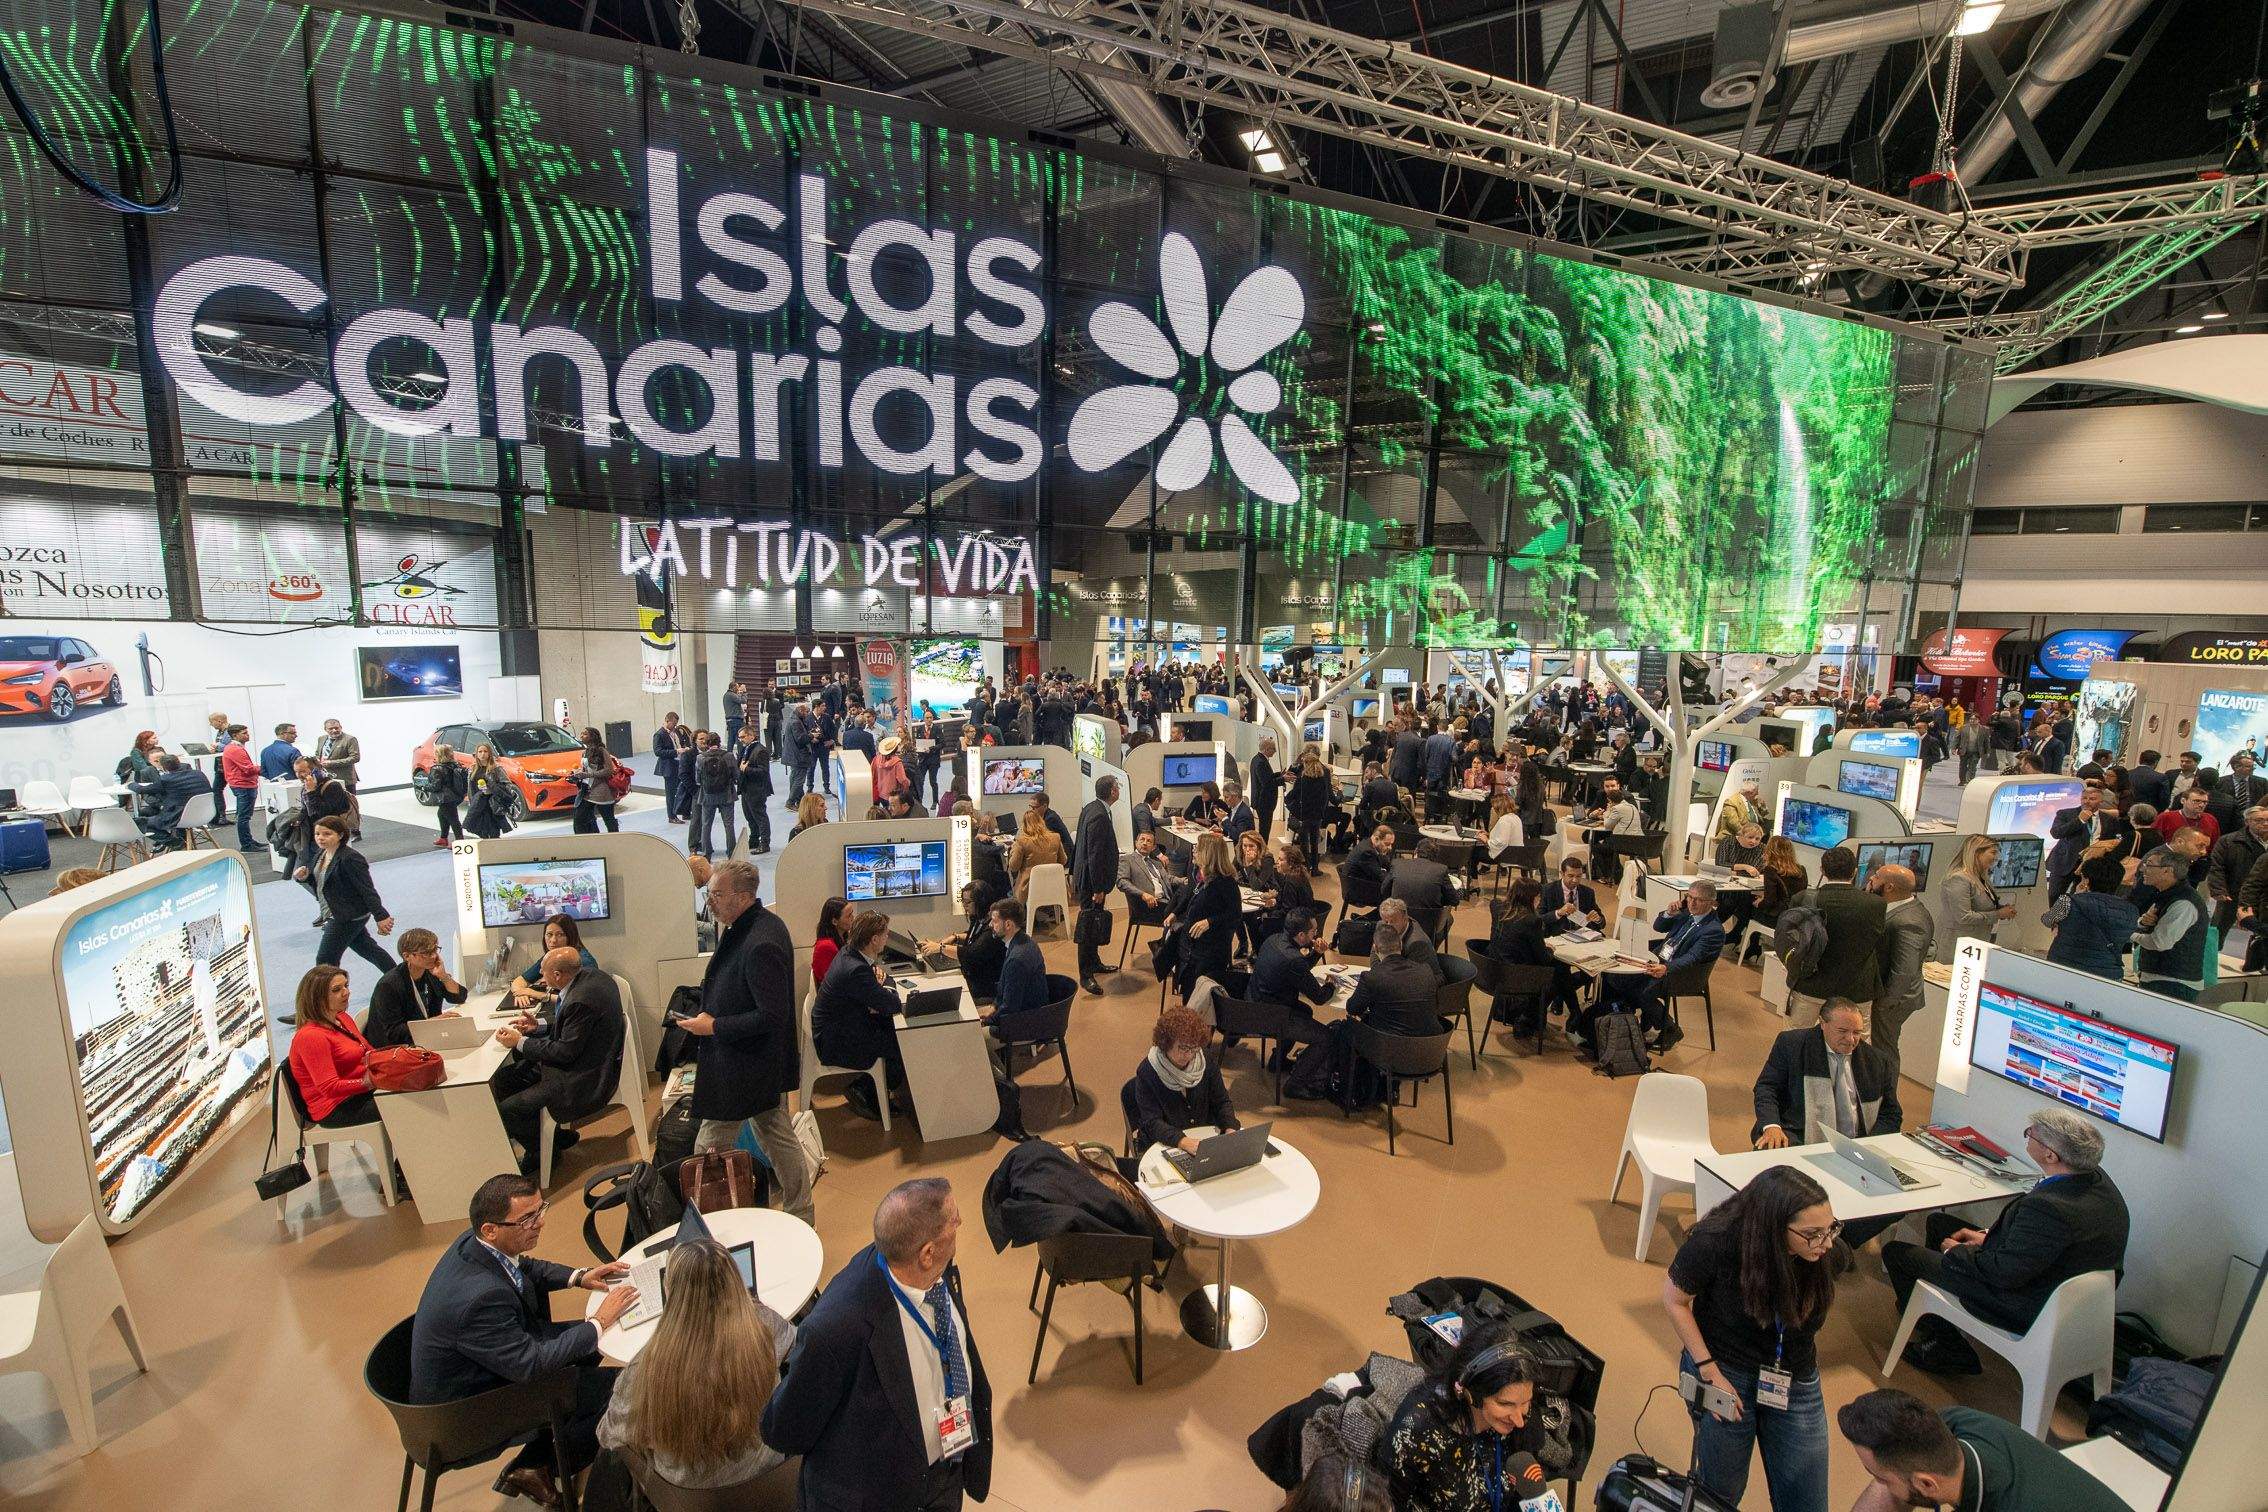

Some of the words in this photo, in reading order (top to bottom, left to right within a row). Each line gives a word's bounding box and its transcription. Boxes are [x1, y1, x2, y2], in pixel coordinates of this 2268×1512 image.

[647, 149, 1046, 347] Islas
[153, 255, 1044, 482] Canarias
[10, 422, 34, 437] de
[42, 426, 114, 448] Coches
[861, 534, 922, 587] DE
[934, 533, 1040, 595] VIDA
[373, 604, 458, 625] CICAR
[867, 651, 894, 667] LUZIA
[2191, 647, 2244, 660] LORO
[2200, 692, 2266, 713] LANZAROTE
[1780, 783, 1790, 791] 39
[956, 819, 968, 829] 19
[454, 844, 474, 856] 20
[462, 867, 474, 912] NORDOTEL
[78, 931, 109, 956] Islas
[109, 908, 160, 940] Canarias
[1961, 945, 1982, 961] 41
[1952, 966, 1972, 1047] CANARIAS.COM
